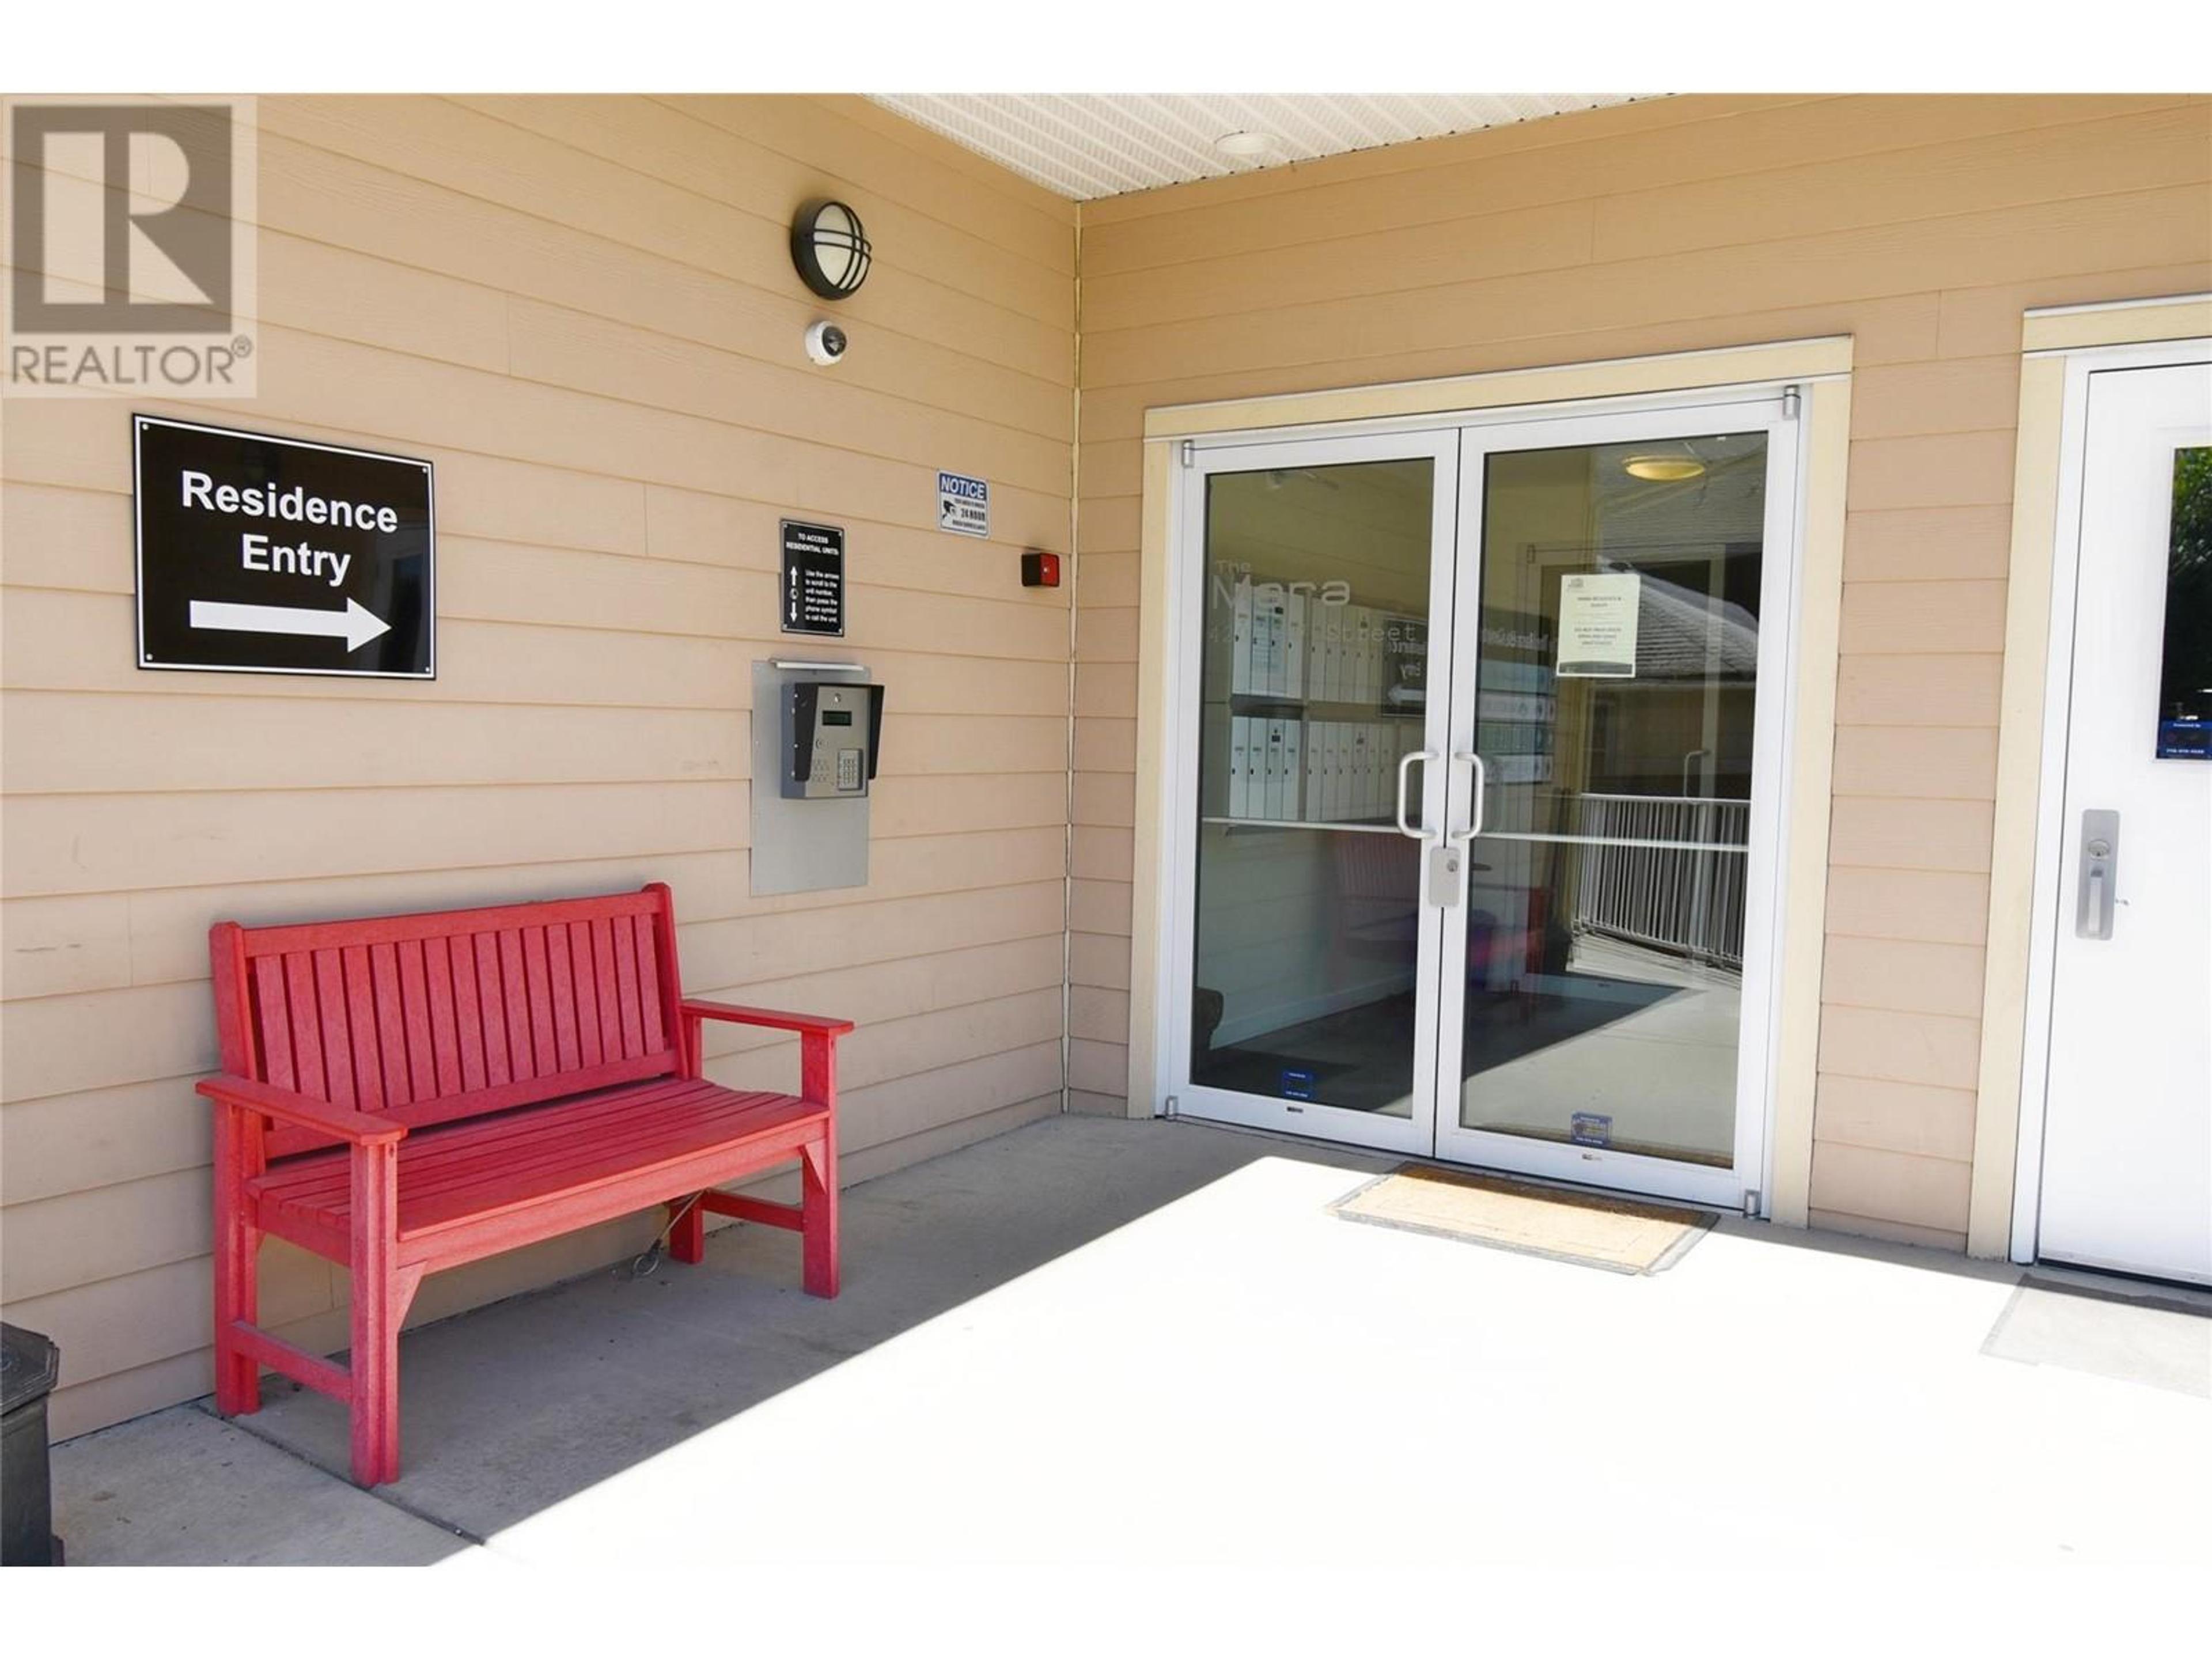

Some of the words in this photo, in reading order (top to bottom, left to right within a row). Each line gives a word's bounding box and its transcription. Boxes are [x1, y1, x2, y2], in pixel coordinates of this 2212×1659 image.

[941, 476, 985, 499] NOTICE
[182, 469, 398, 533] Residence
[798, 532, 806, 540] TO
[806, 535, 829, 544] ACCESS
[786, 541, 821, 554] RESIDENTIAL
[242, 533, 351, 587] Entry
[1216, 559, 1251, 573] The
